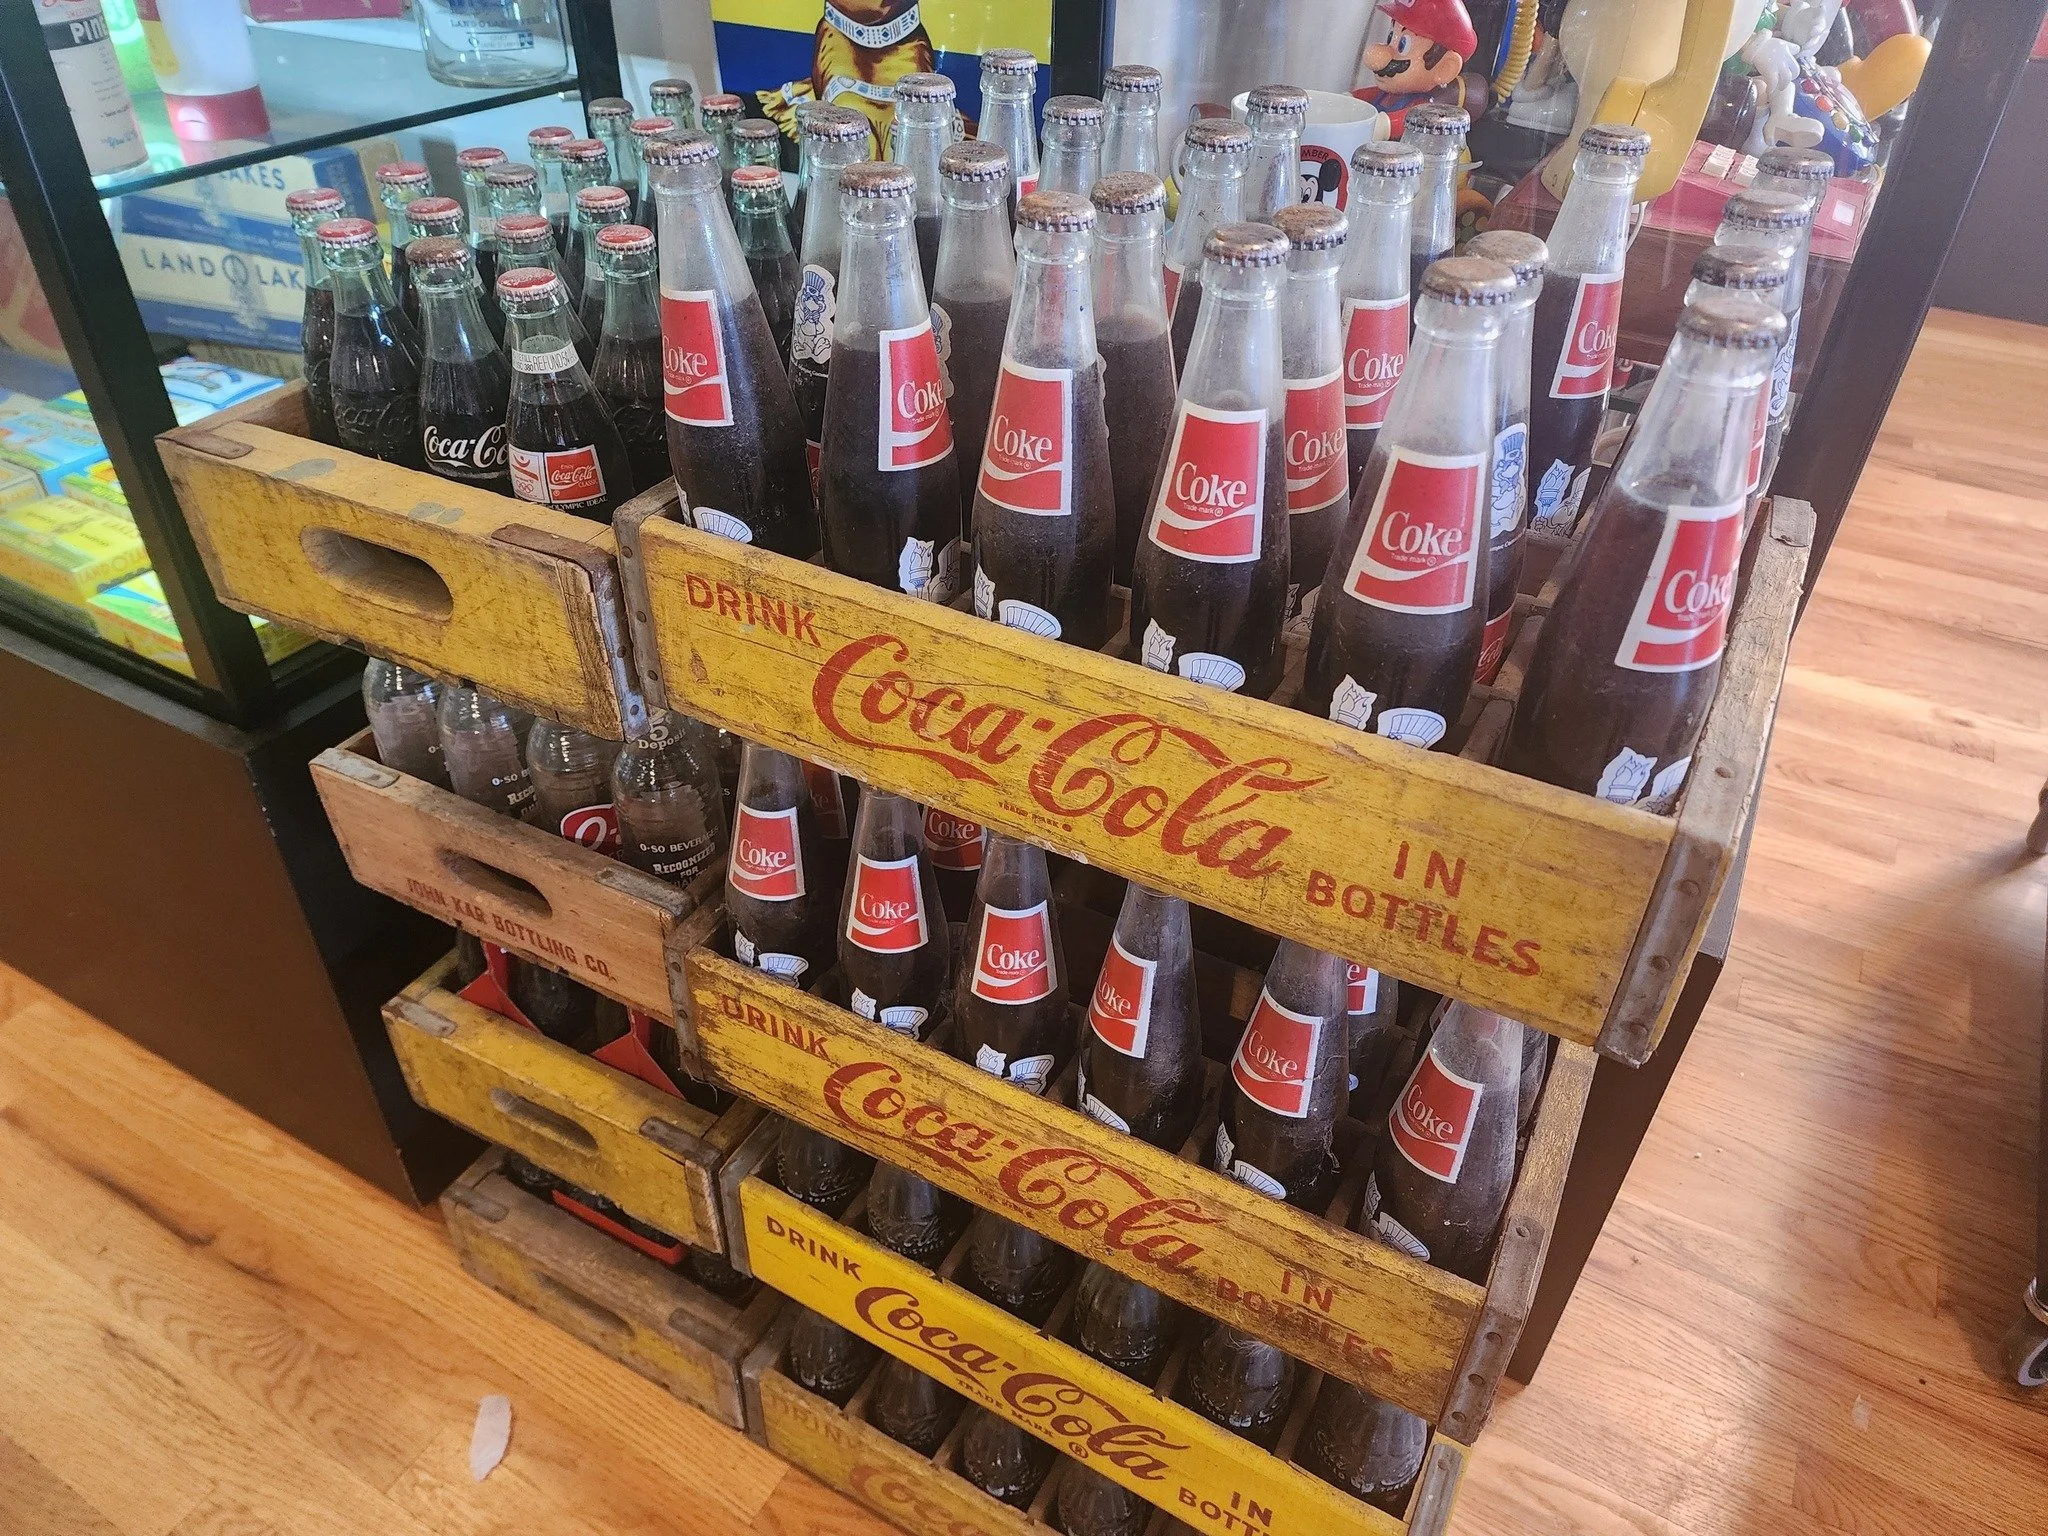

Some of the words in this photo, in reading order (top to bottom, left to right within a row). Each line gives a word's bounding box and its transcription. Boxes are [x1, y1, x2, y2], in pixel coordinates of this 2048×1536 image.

[1301, 148, 1329, 160] MBER
[140, 248, 216, 277] LAND
[254, 264, 305, 290] LAK
[662, 335, 708, 377] Coke
[1347, 348, 1404, 382] Coke
[897, 379, 943, 419] Coke
[423, 423, 509, 469] Coca-Co
[993, 415, 1053, 463] Coke
[1286, 427, 1343, 466] Coke
[550, 466, 595, 484] Coca-Cola
[1176, 461, 1247, 509] Coke
[586, 496, 608, 508] IDEAL
[1381, 510, 1463, 557] Coke
[684, 573, 822, 648] DRINK
[637, 727, 687, 751] Deposit
[812, 632, 1330, 879] Coca-Cola
[639, 843, 666, 853] O-SO
[669, 825, 720, 853] BEVERAGES
[928, 811, 975, 841] Coke
[679, 865, 699, 879] FOR
[740, 838, 787, 868] Coke
[1393, 840, 1467, 900] IN
[860, 892, 910, 919] Coke
[1305, 869, 1543, 977] BOTTLES
[491, 912, 579, 965] BOTTLING
[986, 943, 1040, 970] Coke
[719, 993, 832, 1061] DRINK
[1248, 1029, 1298, 1078] Coke
[1407, 1083, 1454, 1141] Coke
[823, 1060, 1223, 1274] Coca-Cola
[766, 1215, 863, 1283] DRINK
[1280, 1269, 1333, 1314] IN
[855, 1286, 1191, 1481] Coca-Cola
[957, 1378, 1004, 1410] TRADE
[1010, 1409, 1054, 1439] MARK
[1178, 1486, 1271, 1536] BOTT
[1230, 1490, 1273, 1528] IN
